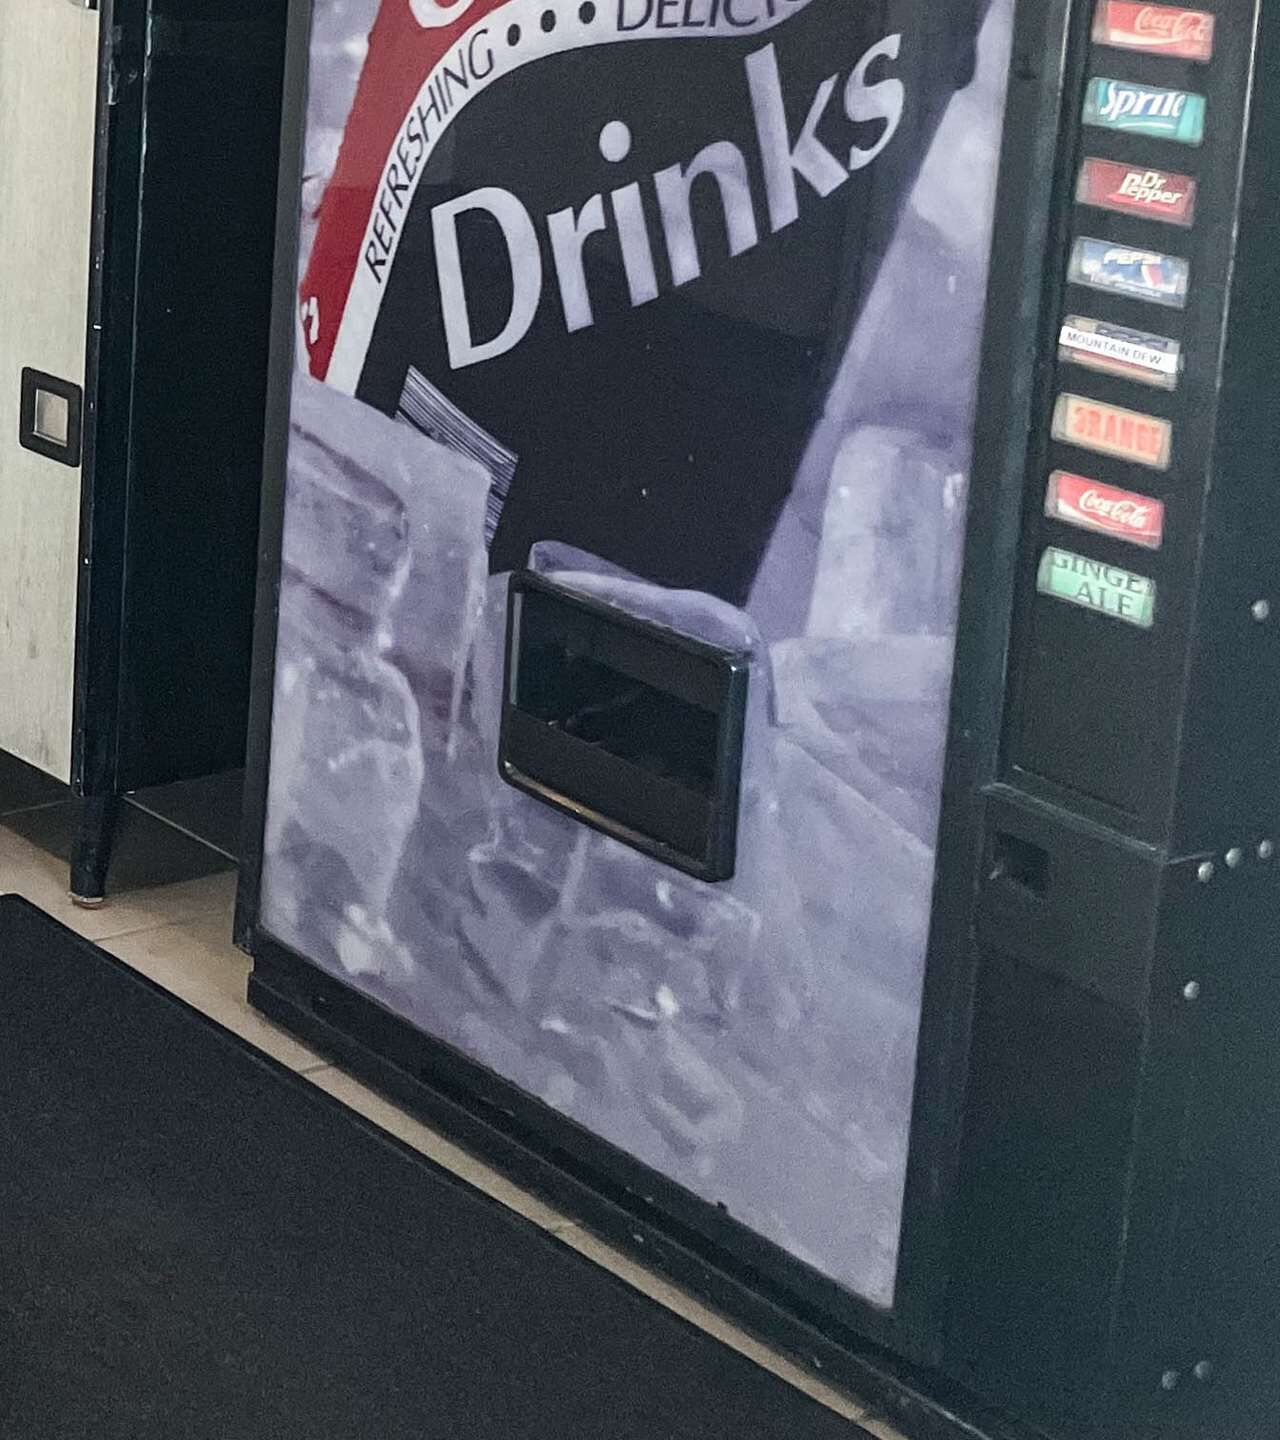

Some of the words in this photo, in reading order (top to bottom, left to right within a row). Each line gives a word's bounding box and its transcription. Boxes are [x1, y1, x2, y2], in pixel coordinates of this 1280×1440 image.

[363, 27, 496, 285] REFRESHING
[1118, 173, 1183, 204] Pepper
[1140, 171, 1165, 189] Dr
[430, 33, 905, 371] Drinks
[1066, 331, 1130, 357] MOUNTAIN
[1132, 347, 1162, 365] DEW
[1072, 405, 1162, 456] ORANGE
[1075, 581, 1134, 617] ALE
